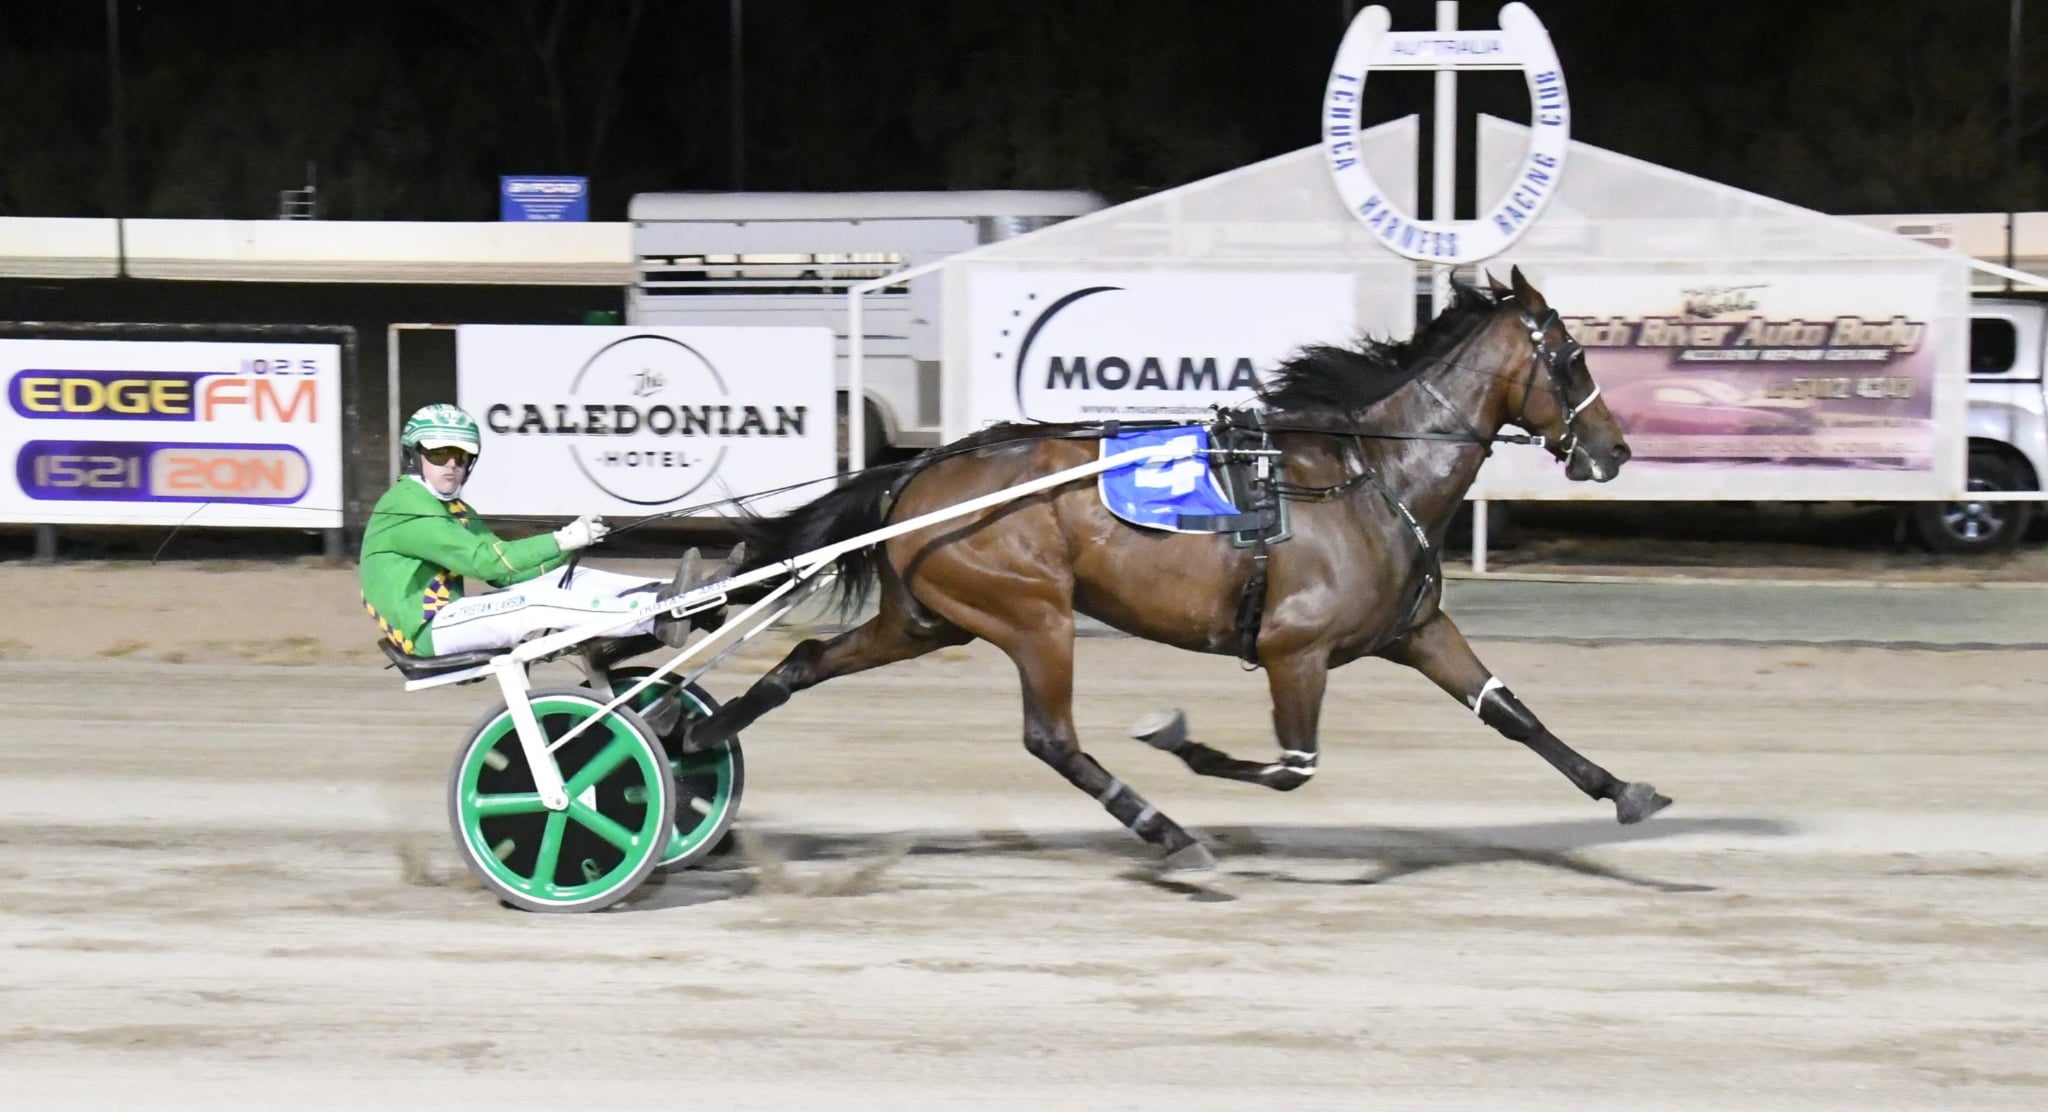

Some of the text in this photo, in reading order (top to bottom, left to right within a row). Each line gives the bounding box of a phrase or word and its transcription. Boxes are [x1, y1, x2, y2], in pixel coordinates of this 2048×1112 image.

[1391, 39, 1503, 56] AUTRALIA
[1358, 194, 1458, 257] HARNESS
[1493, 152, 1558, 236] RACING
[1535, 70, 1562, 126] CLUB
[1637, 316, 1732, 347] River
[1735, 316, 1825, 347] Auto
[1829, 315, 1923, 352] Body
[630, 369, 667, 396] The
[1046, 355, 1260, 391] MOAMA
[20, 376, 318, 423] EDGE FM
[486, 402, 807, 437] CALEDONIAN
[34, 456, 141, 488] 1521
